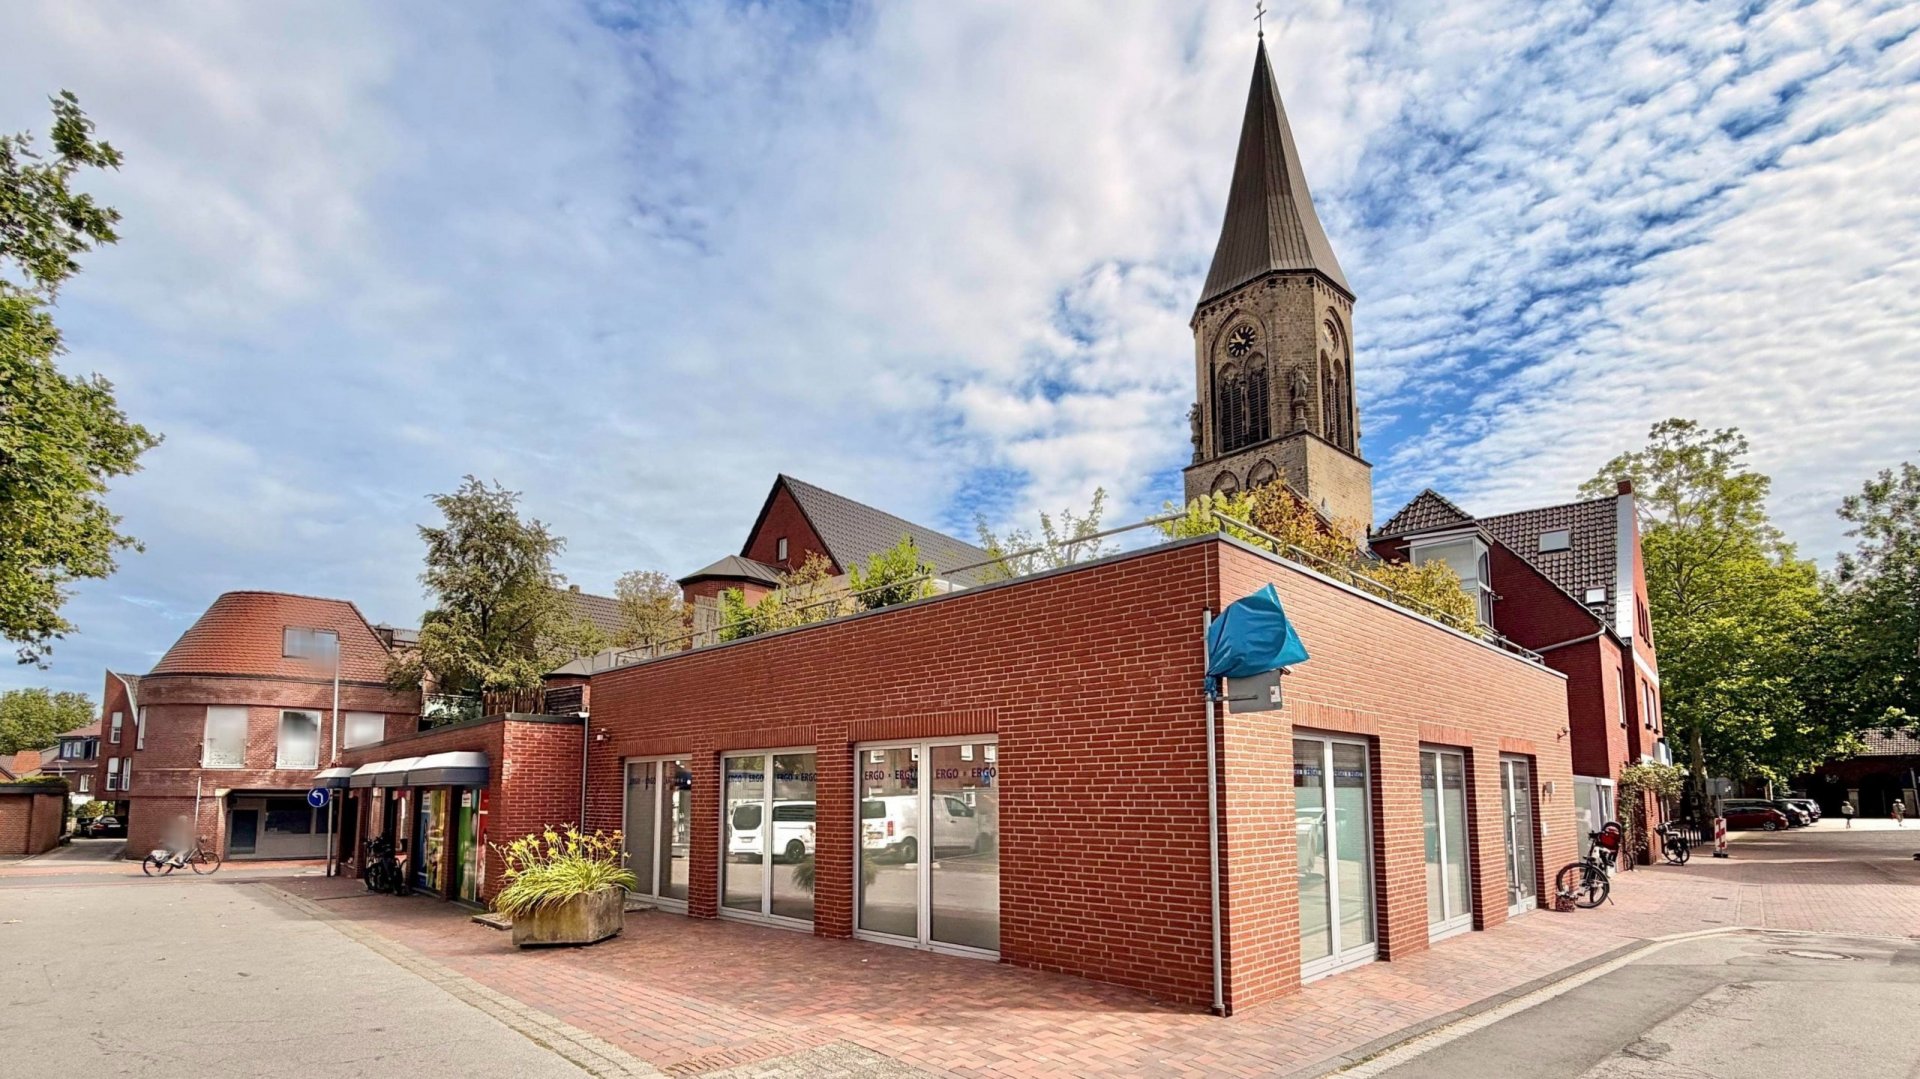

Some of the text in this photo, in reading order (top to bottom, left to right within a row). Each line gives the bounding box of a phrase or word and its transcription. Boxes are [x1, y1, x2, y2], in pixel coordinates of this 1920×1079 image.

[749, 773, 764, 782] ERGO
[864, 770, 885, 780] ERGO
[935, 767, 997, 779] ERGO ERGO
